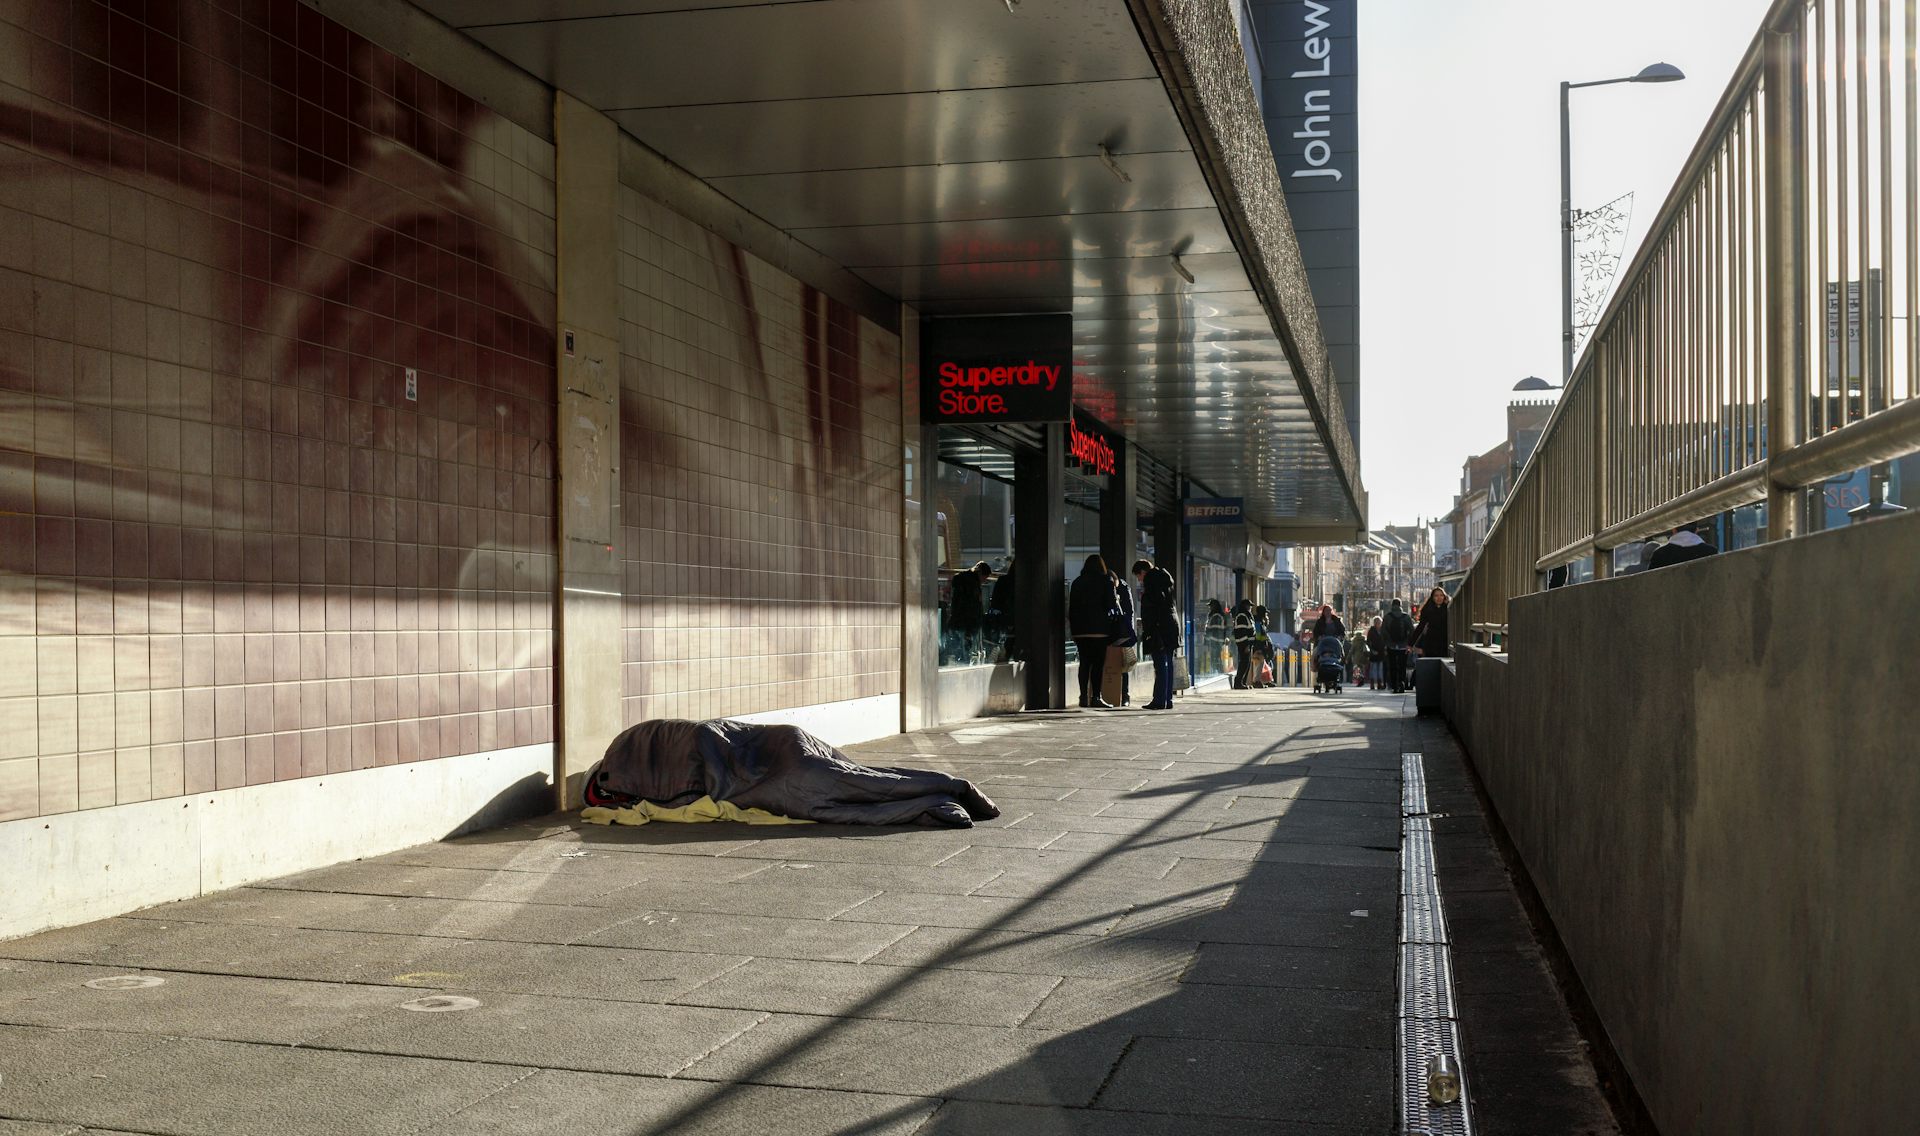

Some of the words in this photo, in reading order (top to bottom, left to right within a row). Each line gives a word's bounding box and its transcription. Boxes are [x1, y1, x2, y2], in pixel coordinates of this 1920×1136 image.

[1291, 0, 1331, 78] Lew
[1291, 90, 1342, 182] John
[939, 360, 1060, 393] Superdry
[939, 389, 1008, 415] Store.
[1070, 417, 1100, 477] Superdry
[1187, 506, 1240, 517] BETFRED
